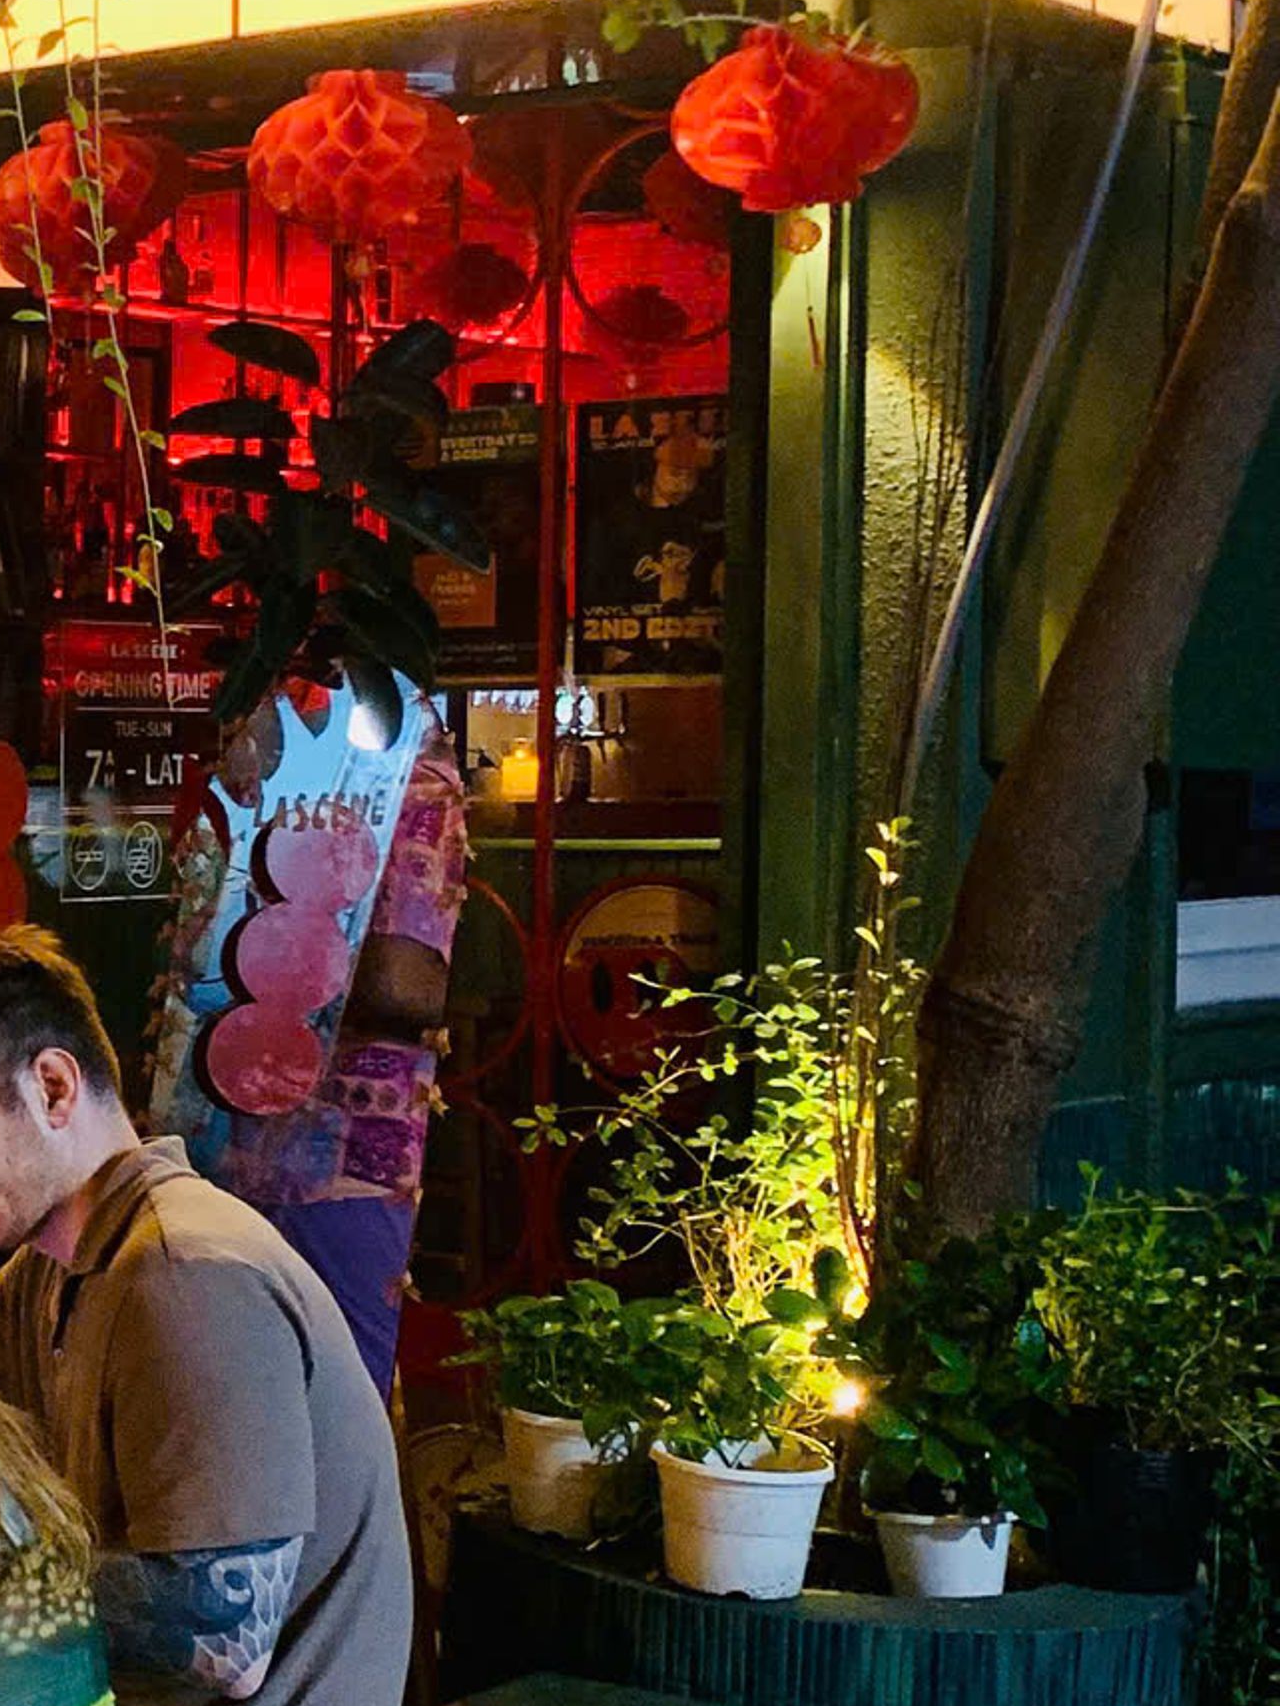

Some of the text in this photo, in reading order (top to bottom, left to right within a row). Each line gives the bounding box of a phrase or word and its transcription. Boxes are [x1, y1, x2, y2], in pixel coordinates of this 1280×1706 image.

[583, 618, 640, 640] 2ND
[73, 670, 212, 700] OPENING TIME
[145, 753, 200, 786] LAT
